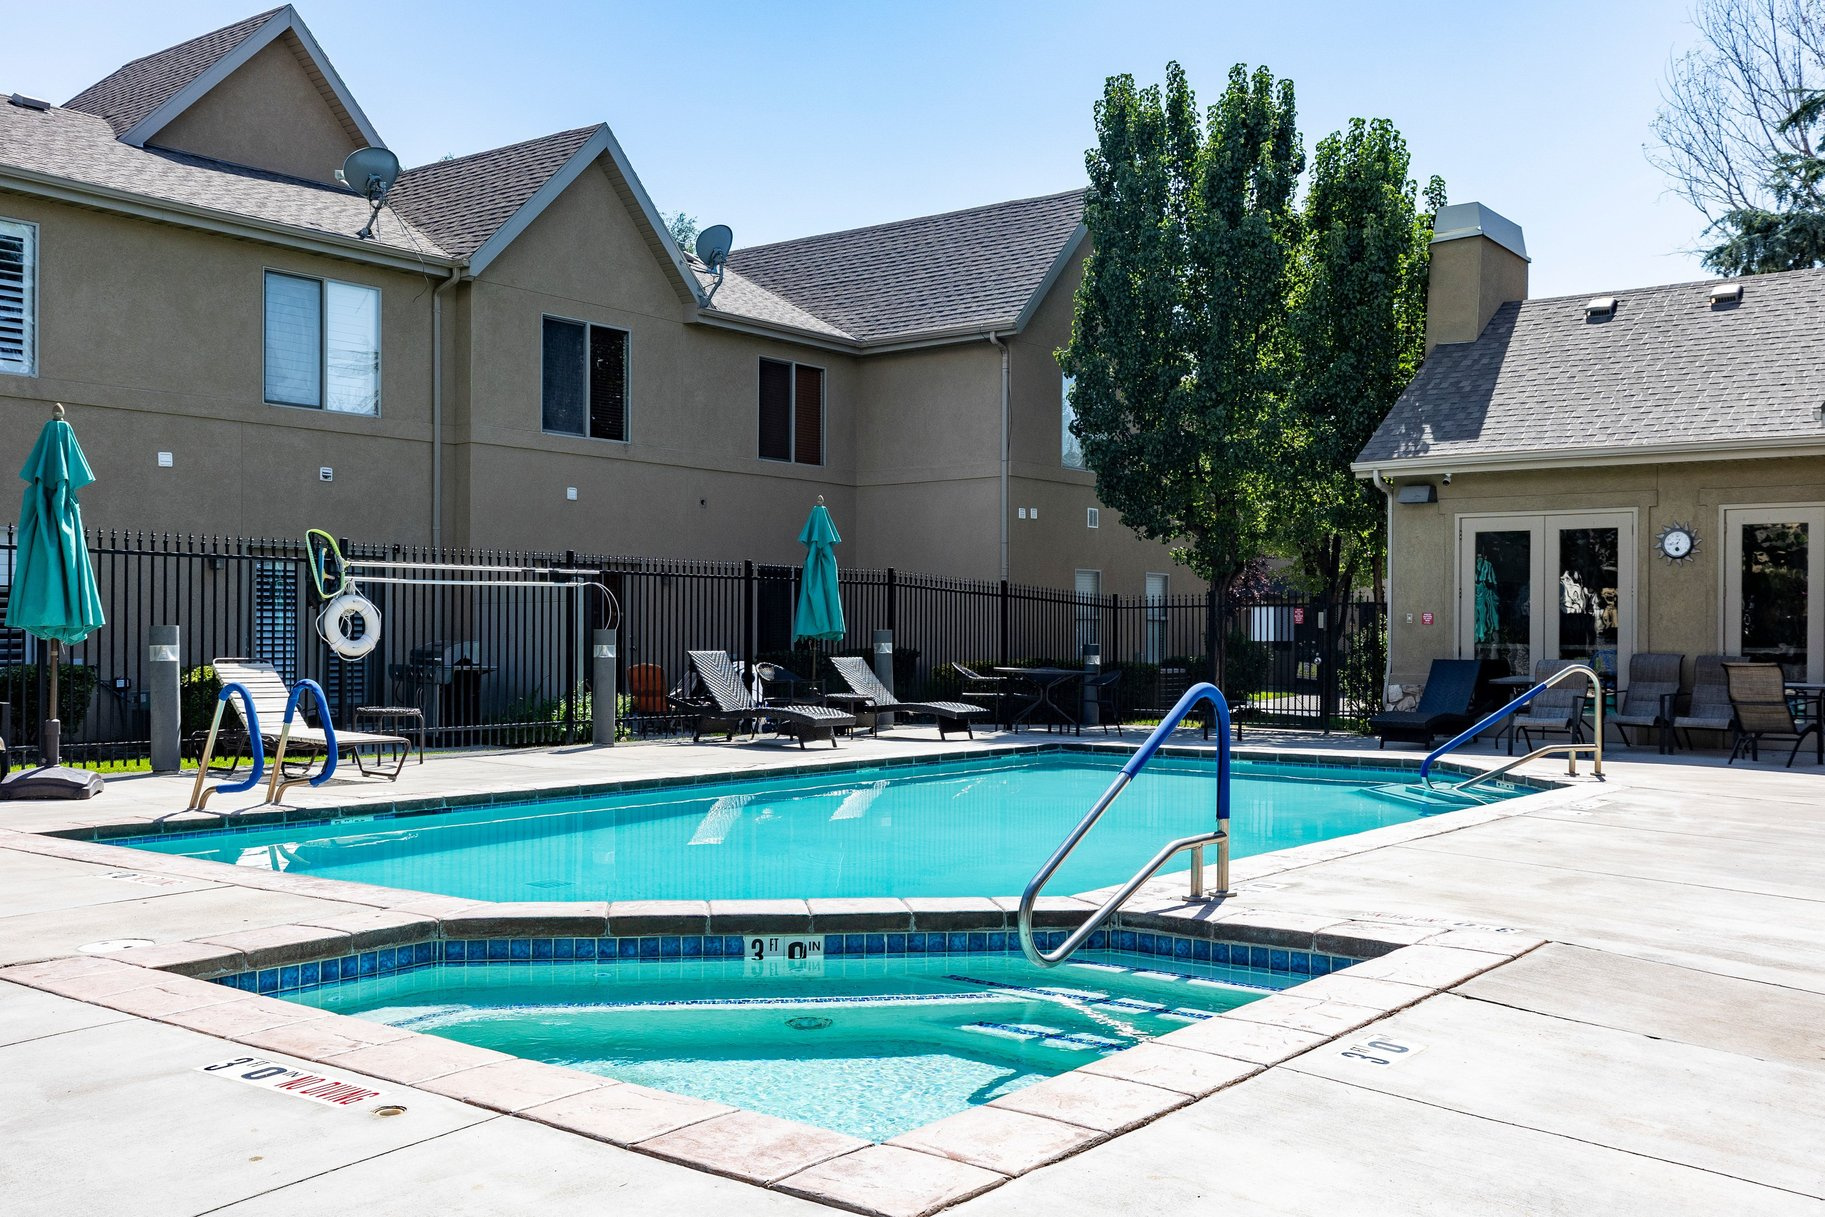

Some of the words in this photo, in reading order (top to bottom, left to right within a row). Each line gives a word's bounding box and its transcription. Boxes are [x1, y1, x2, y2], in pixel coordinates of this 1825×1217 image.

[751, 938, 764, 960] 3
[769, 938, 779, 951] FT
[788, 941, 807, 960] 0
[808, 941, 821, 951] IN
[1341, 1051, 1390, 1065] 3
[1367, 1040, 1410, 1054] 0
[203, 1057, 254, 1071] 3
[240, 1066, 288, 1080] 0
[273, 1075, 327, 1090] NO
[299, 1081, 380, 1105] DIVING
